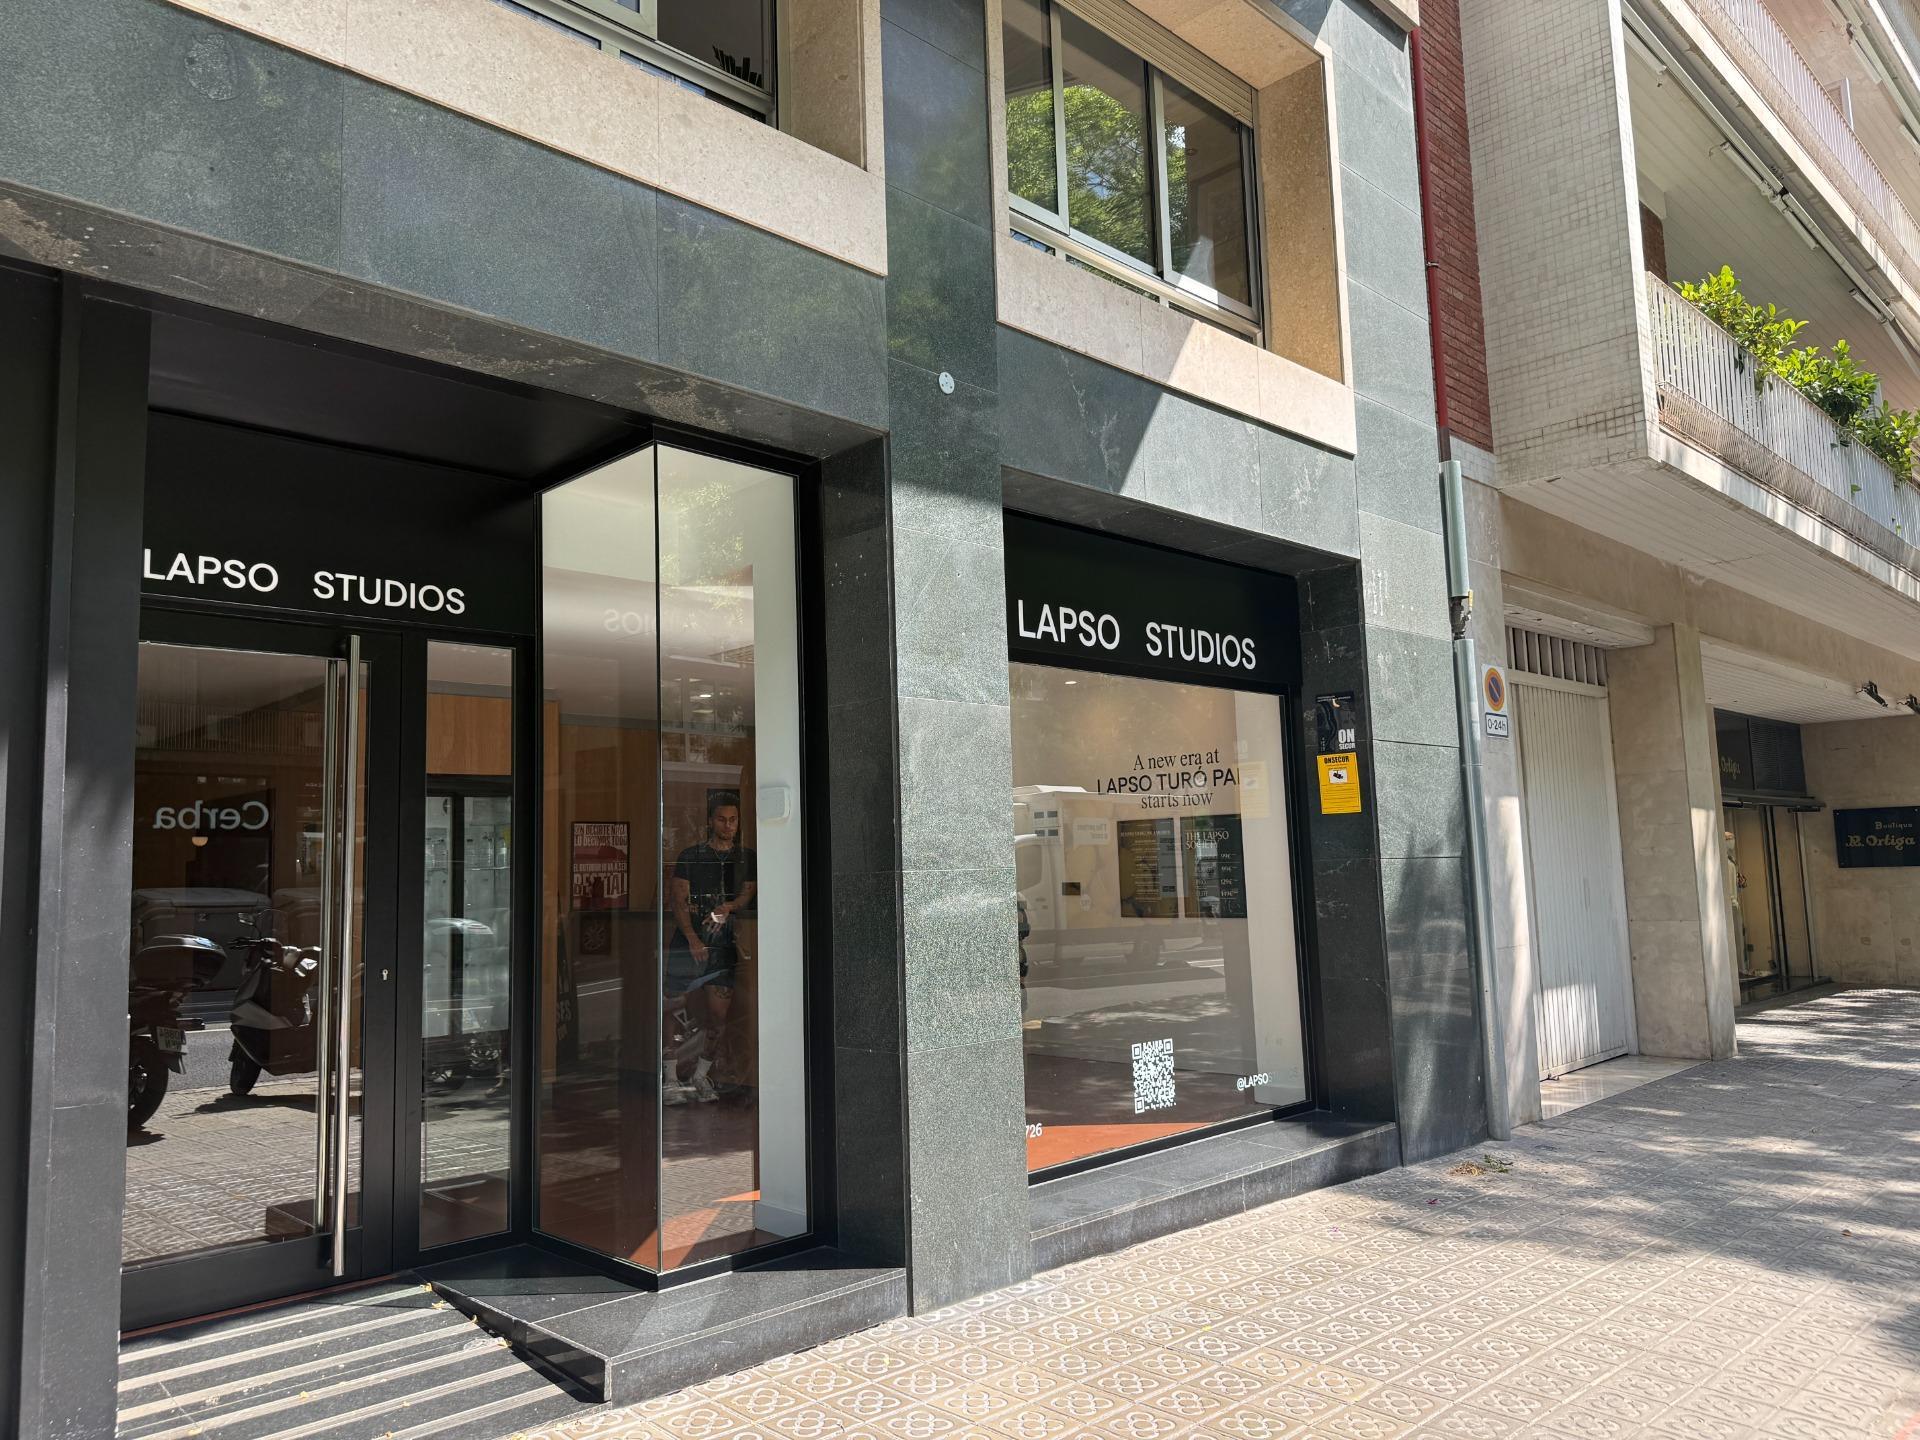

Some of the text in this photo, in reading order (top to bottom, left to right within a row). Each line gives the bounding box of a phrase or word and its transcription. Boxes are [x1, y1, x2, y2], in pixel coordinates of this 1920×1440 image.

[143, 548, 466, 615] LAPSO STUDIOS
[1017, 599, 1257, 670] LAPSO STUDIOS
[1338, 728, 1355, 743] ON
[1338, 742, 1356, 750] SECUR
[1133, 748, 1220, 771] A new era at
[1324, 755, 1349, 764] ONSECUR
[1097, 774, 1153, 796] LAPSO
[1156, 766, 1207, 790] TURÓ
[1141, 791, 1214, 809] starts now
[1203, 830, 1230, 841] LAPSO
[1866, 833, 1916, 851] Ortiga
